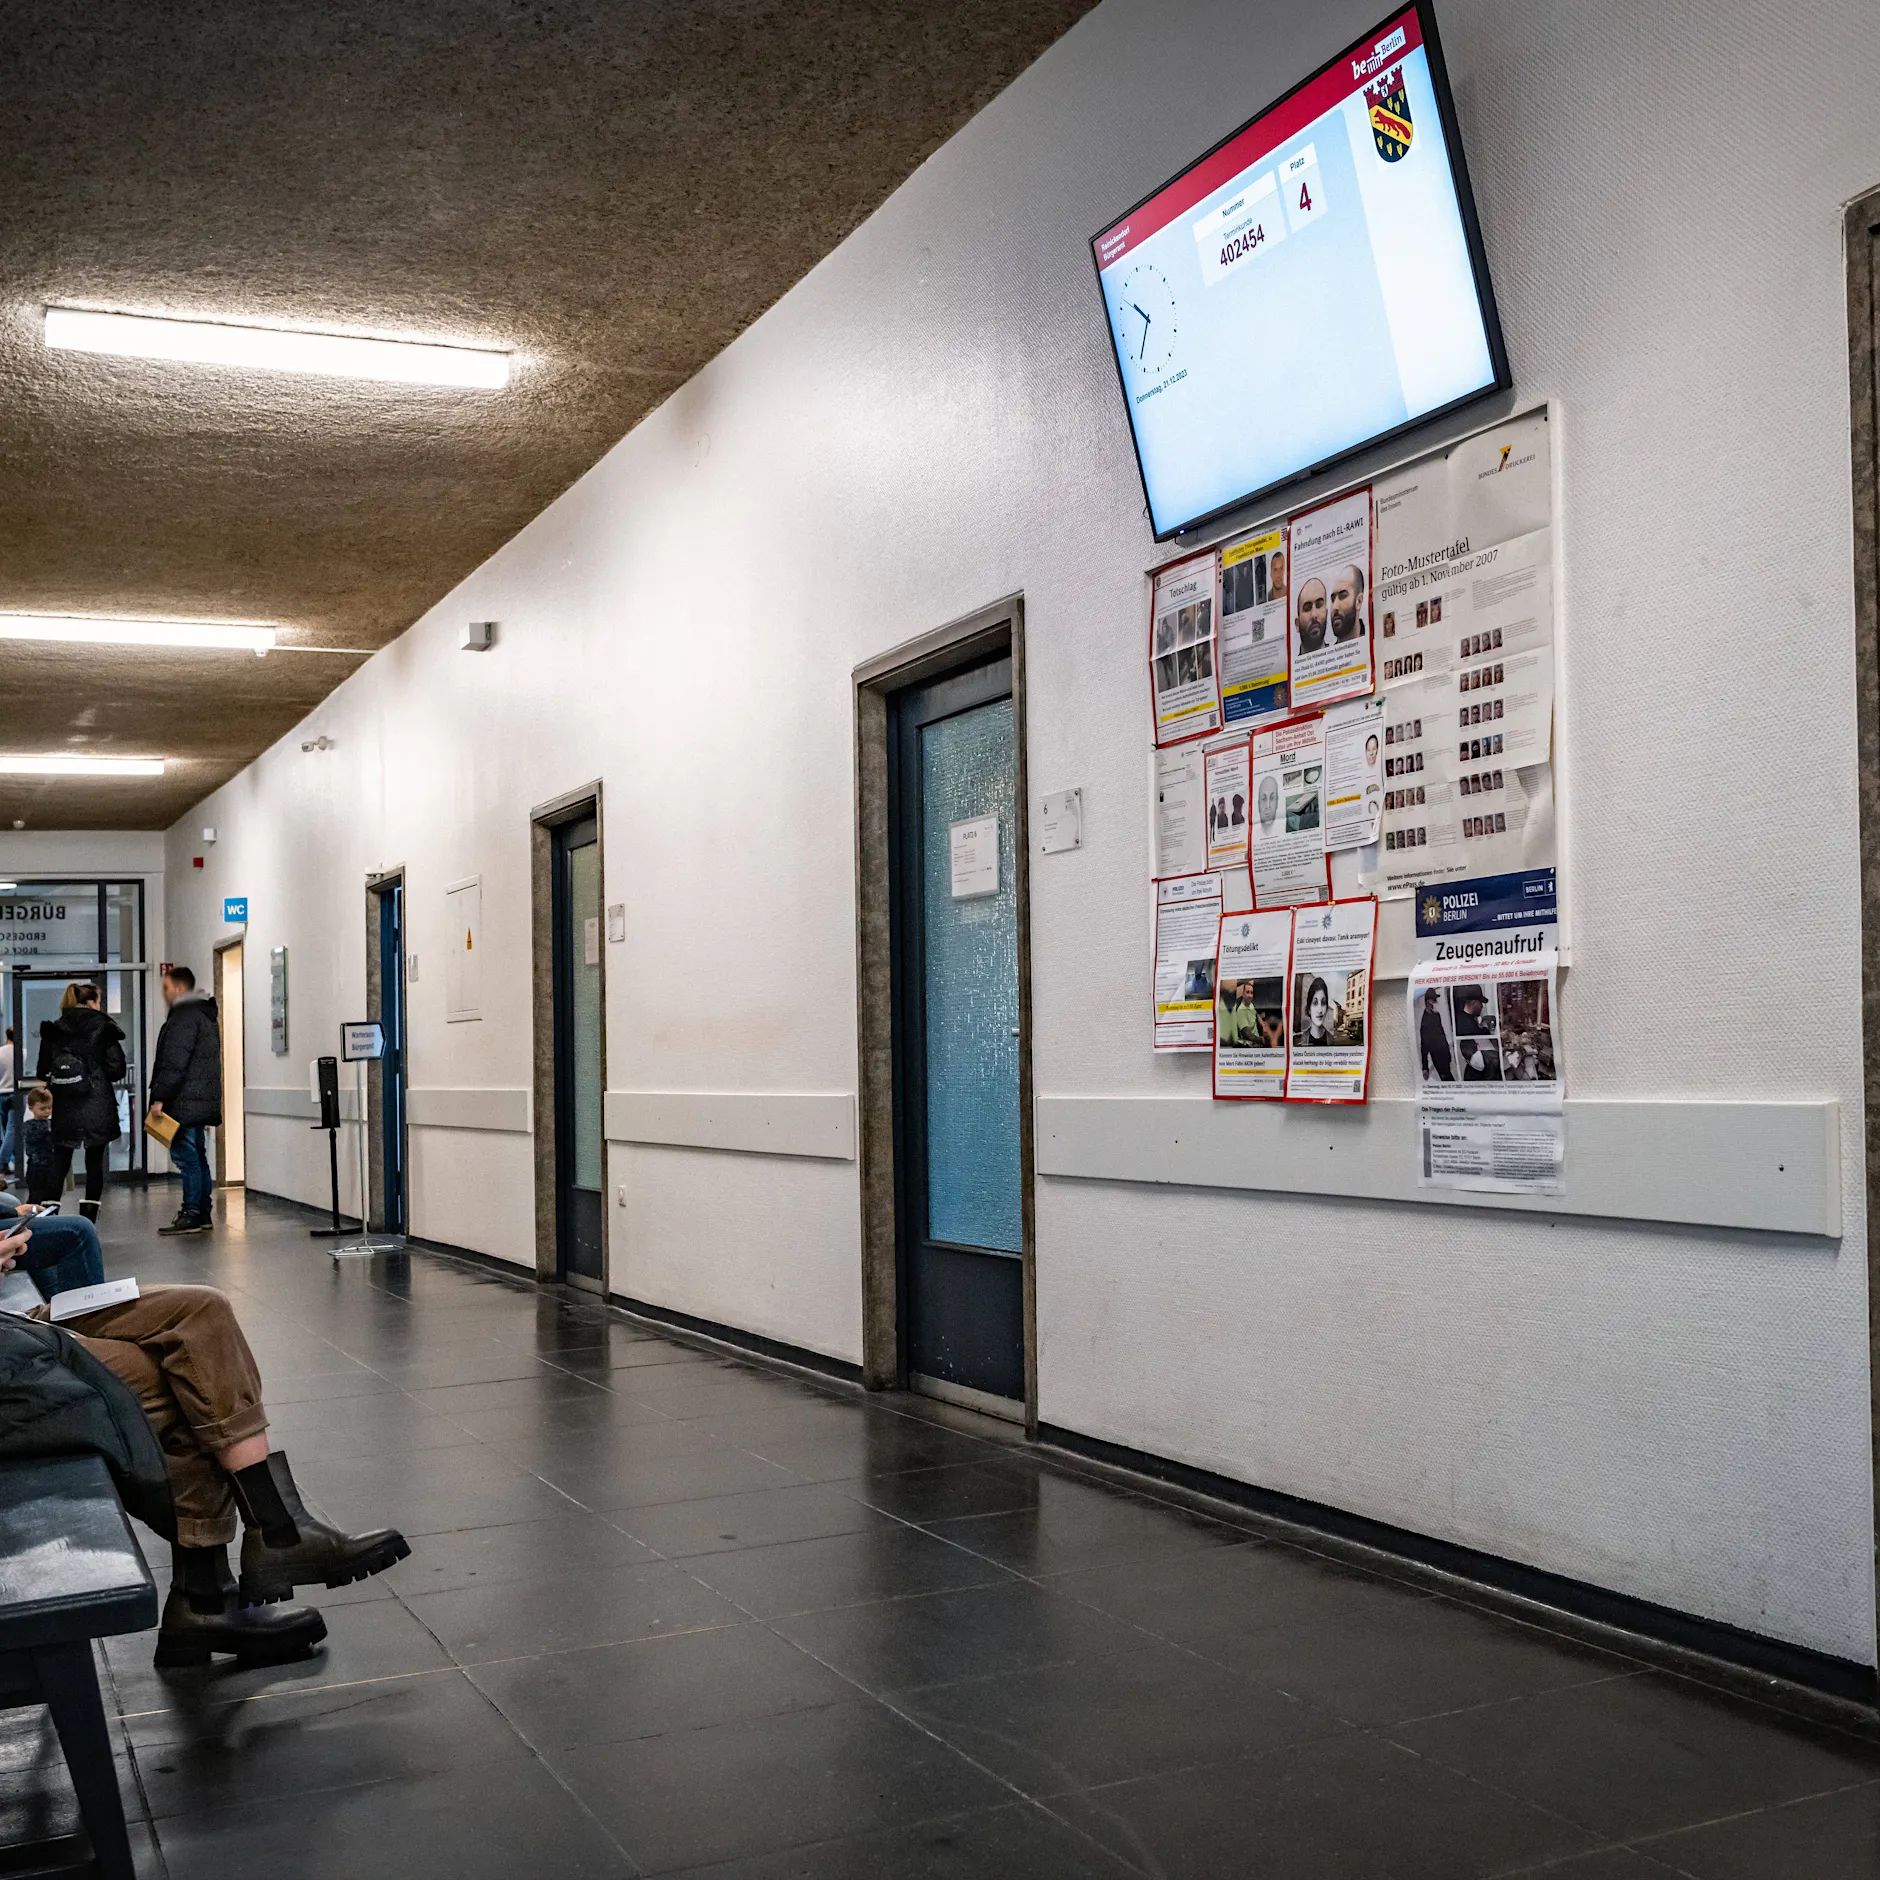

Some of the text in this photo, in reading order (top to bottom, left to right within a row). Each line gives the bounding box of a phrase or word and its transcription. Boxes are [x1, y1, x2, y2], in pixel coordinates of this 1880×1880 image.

[1380, 35, 1403, 55] Berlin
[1290, 158, 1305, 171] Platz
[1300, 182, 1312, 211] 4
[1222, 199, 1245, 218] Nummer
[1223, 217, 1253, 240] Terminkunde
[1220, 223, 1265, 266] 402454
[1478, 454, 1536, 480] BUNDES DRUCKEREI
[1294, 536, 1322, 552] Fahndung
[1322, 529, 1336, 541] nach
[1336, 517, 1364, 535] EL-RAWI
[1381, 537, 1470, 581] Foto-Mustertafel
[1381, 549, 1499, 602] gültig ab 1. November 2007
[1170, 581, 1197, 599] Totschlag
[1280, 751, 1296, 762] Mord
[1044, 804, 1048, 815] 6
[1525, 885, 1543, 893] BERLIN
[227, 904, 245, 915] WC
[1443, 892, 1479, 909] POLIZEI
[1443, 909, 1467, 922] BERLIN
[1497, 912, 1514, 921] BITTET
[1514, 911, 1523, 919] UM
[1523, 909, 1534, 918] IHRE
[1222, 942, 1259, 954] Tötungsdelikt
[1436, 931, 1544, 963] Zeugenaufruf
[1414, 976, 1425, 984] WER
[1426, 976, 1442, 984] KENNT
[1443, 975, 1457, 983] DIESE
[1458, 973, 1482, 982] PERSON?
[1519, 969, 1549, 977] Belohnung!
